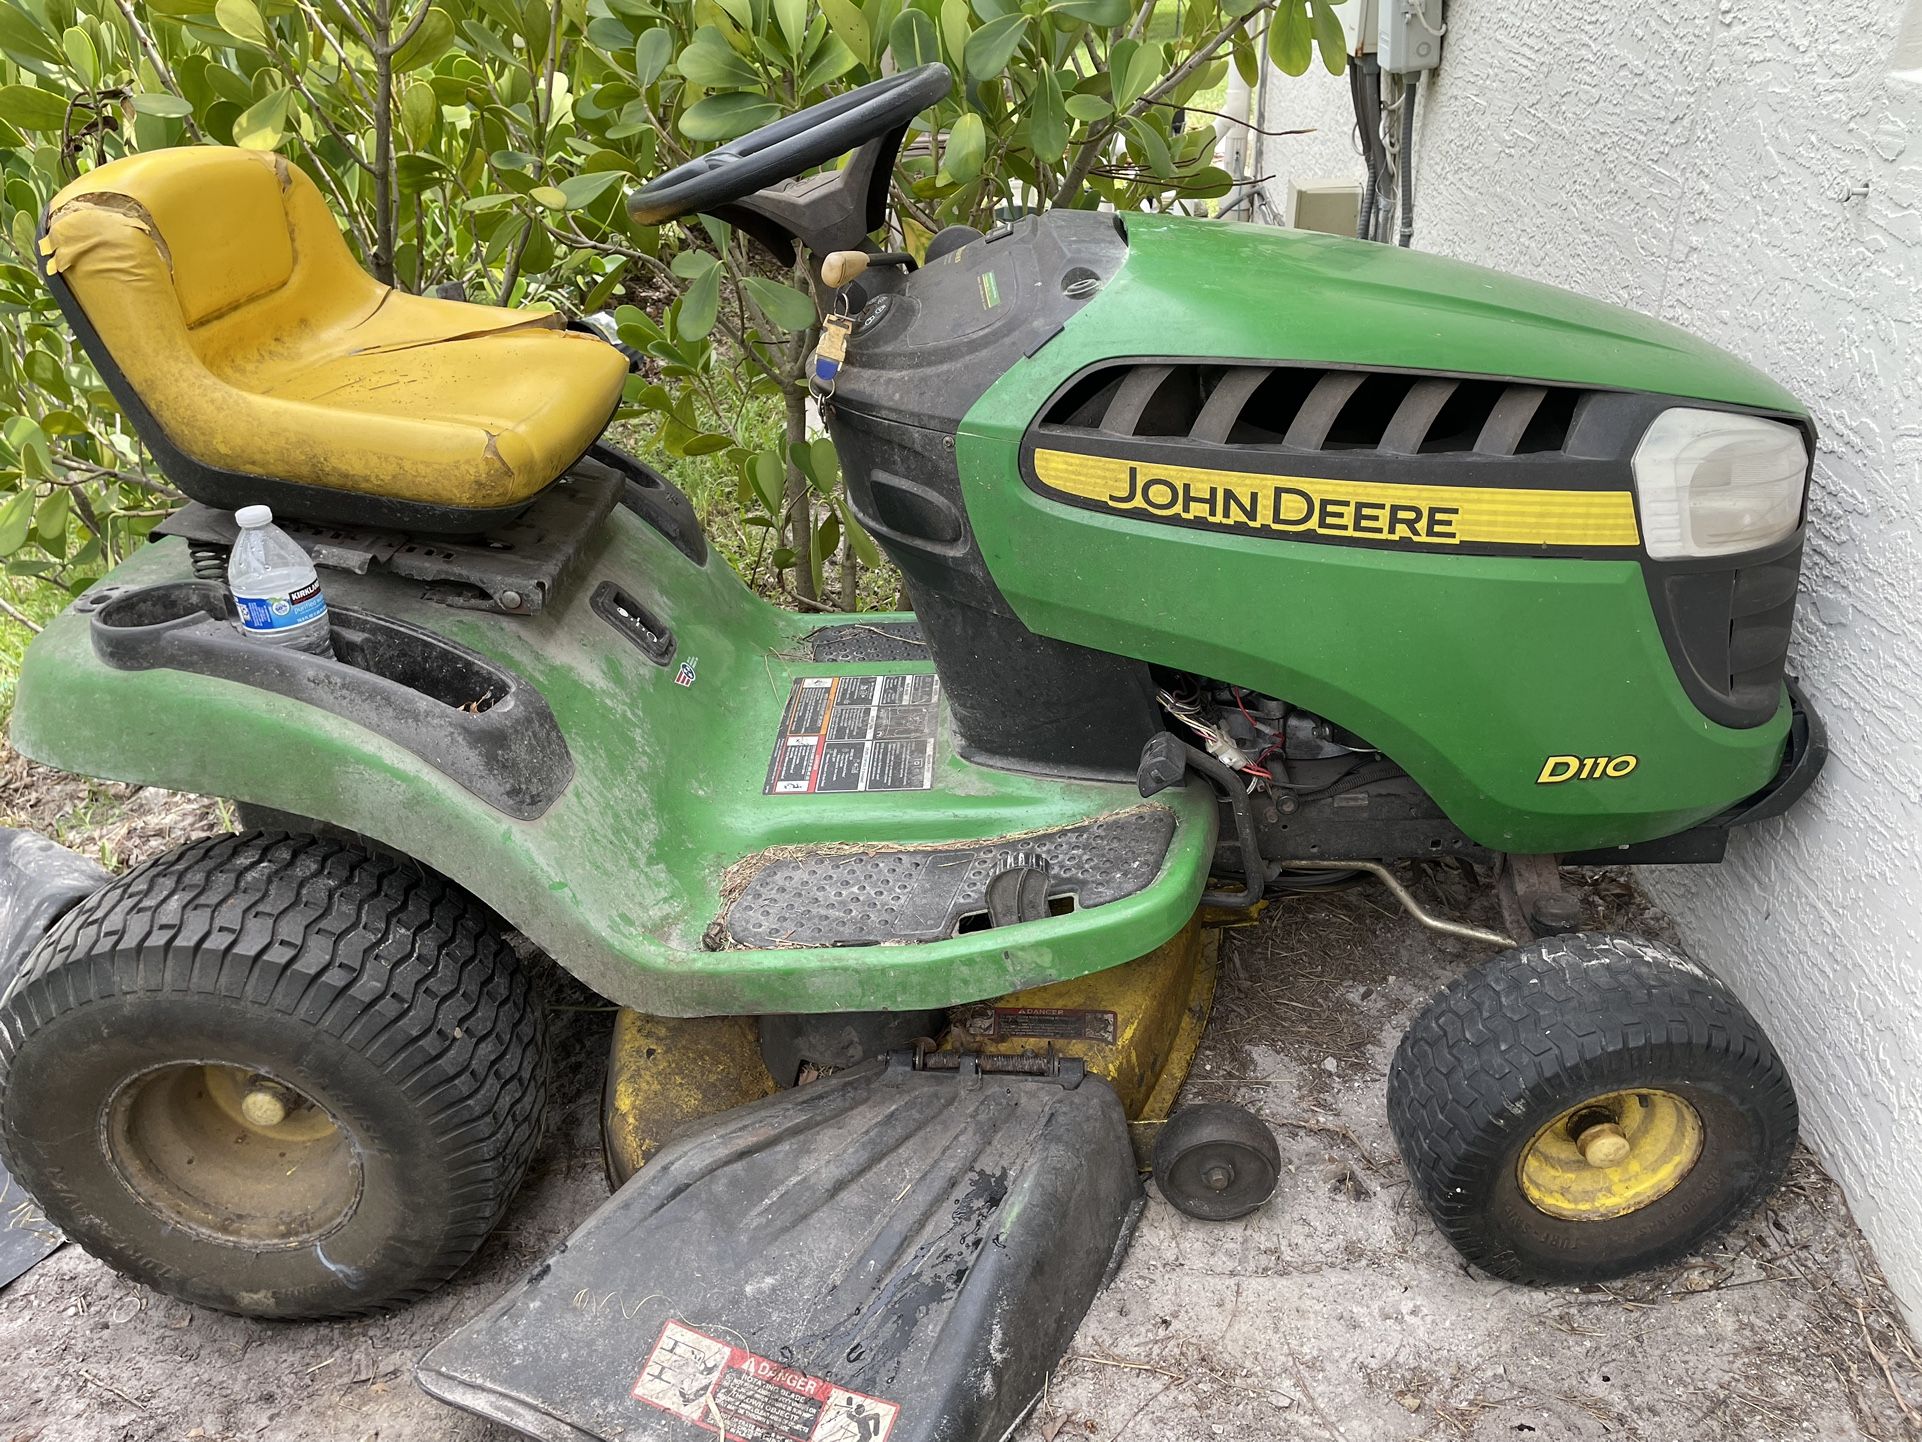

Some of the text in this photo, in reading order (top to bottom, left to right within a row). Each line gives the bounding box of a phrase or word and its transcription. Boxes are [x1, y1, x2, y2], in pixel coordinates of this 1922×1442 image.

[1109, 466, 1460, 539] JOHN DEERE
[1536, 754, 1638, 784] D110
[757, 1360, 818, 1395] DANGER
